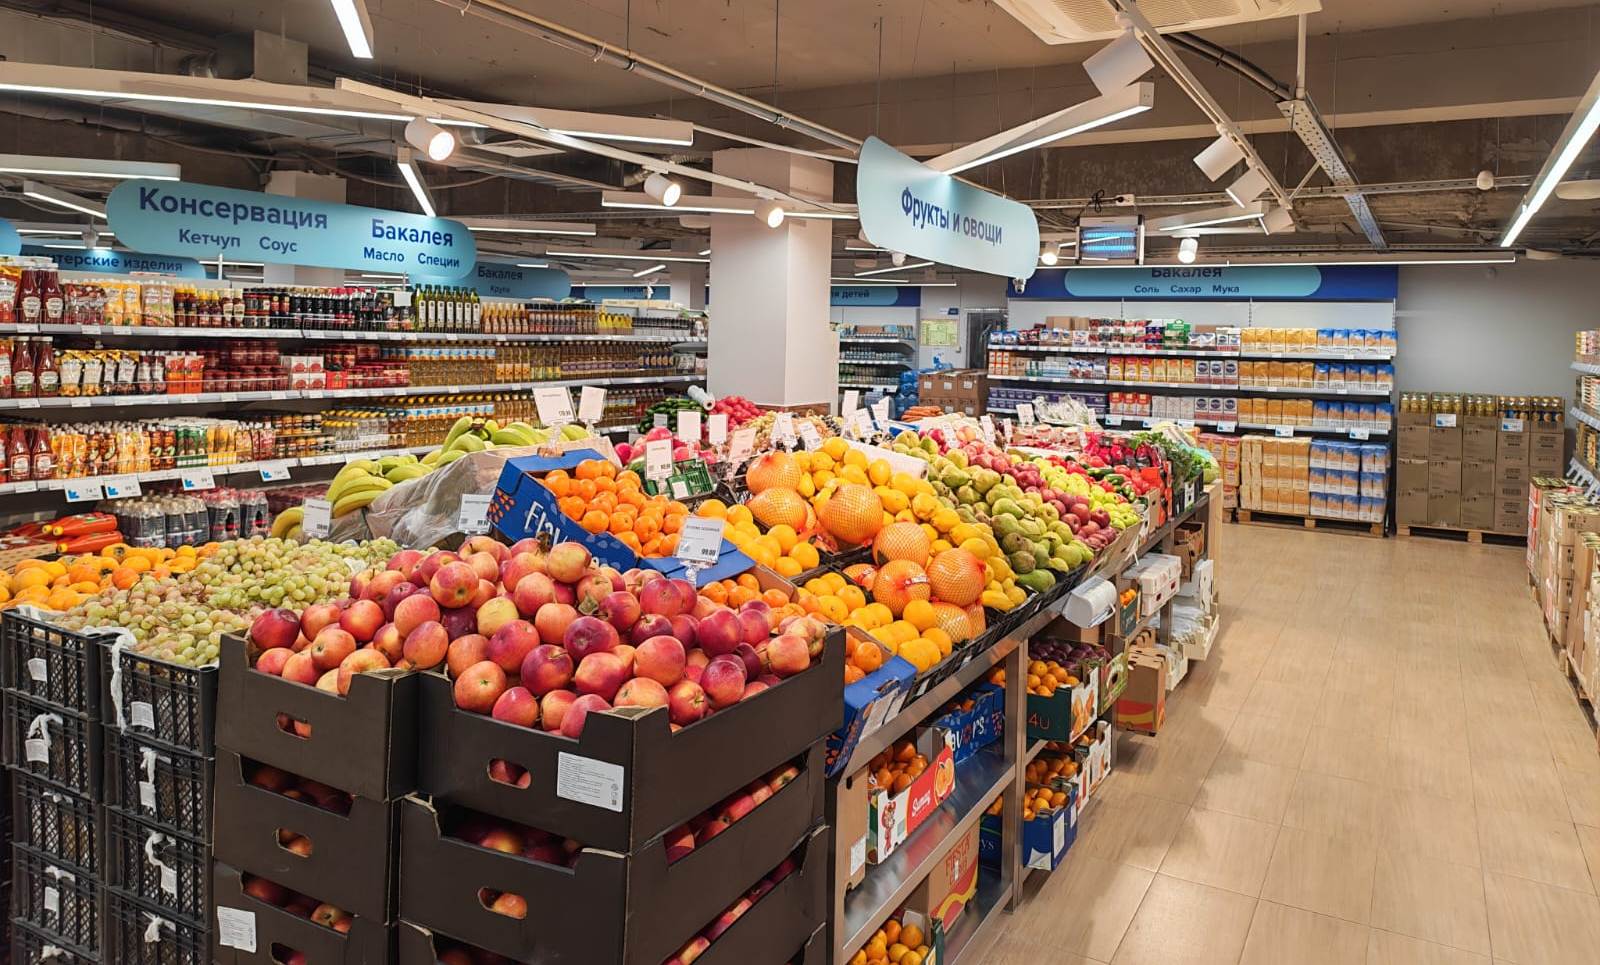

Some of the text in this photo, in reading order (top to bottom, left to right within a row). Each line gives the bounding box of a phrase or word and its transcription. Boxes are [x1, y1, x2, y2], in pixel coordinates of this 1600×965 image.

[140, 187, 327, 229] Консервация
[902, 187, 1002, 246] Фрукты и овощи
[179, 229, 297, 254] Кетчуп Соус
[372, 218, 453, 247] Бакалея
[124, 258, 183, 272] изделия
[364, 247, 460, 268] Масло Специи
[478, 266, 522, 280] Бакалея
[1134, 284, 1240, 294] Соль Сахар Мука
